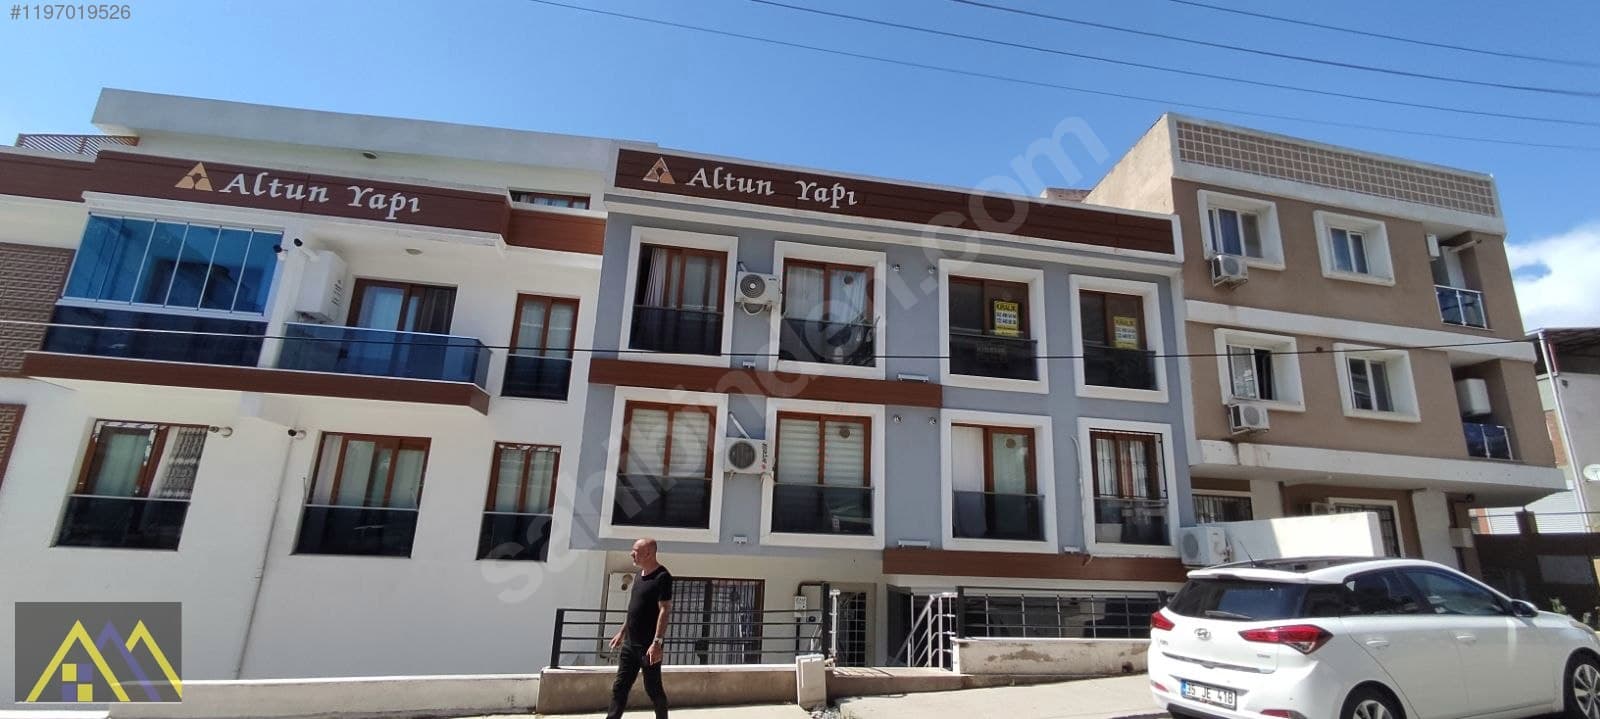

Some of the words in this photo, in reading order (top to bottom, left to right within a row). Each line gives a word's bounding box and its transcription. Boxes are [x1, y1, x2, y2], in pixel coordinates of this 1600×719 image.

[219, 172, 329, 203] Altun
[347, 185, 421, 220] Yapı
[685, 166, 775, 196] Altun
[795, 180, 858, 209] Yapı
[1201, 686, 1211, 699] JE
